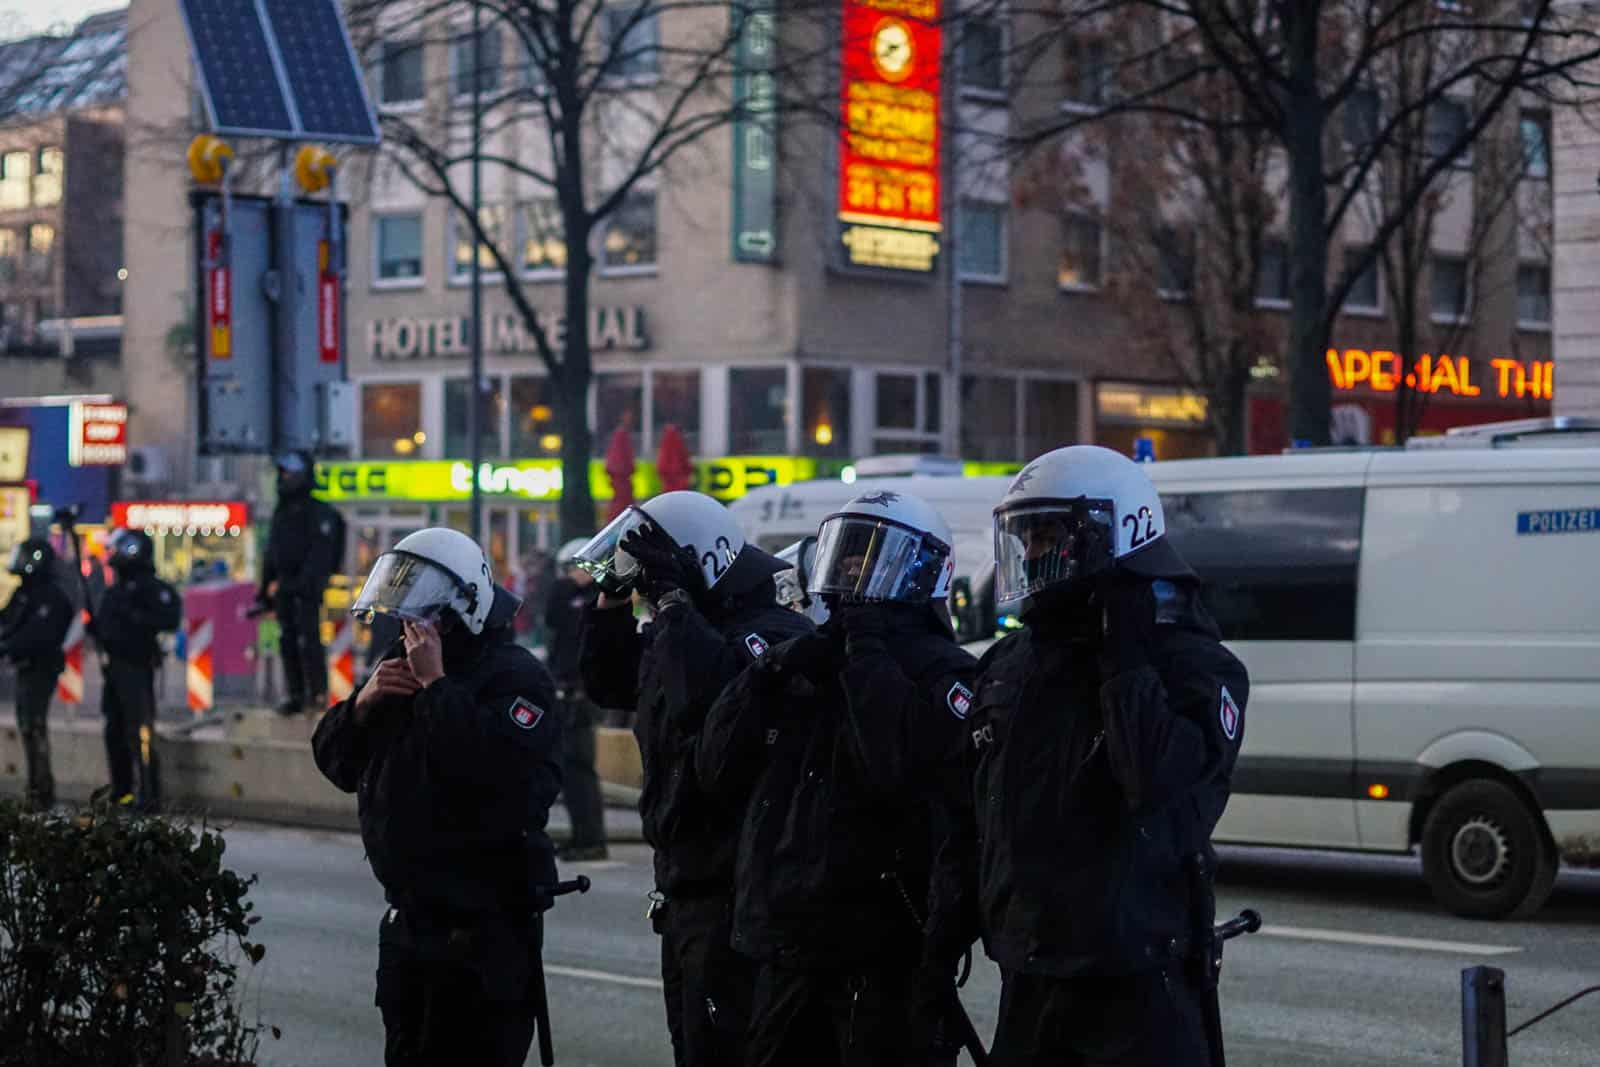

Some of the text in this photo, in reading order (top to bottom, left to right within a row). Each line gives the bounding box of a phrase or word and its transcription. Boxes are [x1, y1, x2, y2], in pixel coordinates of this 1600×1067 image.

[367, 318, 470, 357] HOTEL
[1122, 505, 1157, 549] 22
[1529, 511, 1594, 534] POLIZEI
[702, 536, 737, 580] 22
